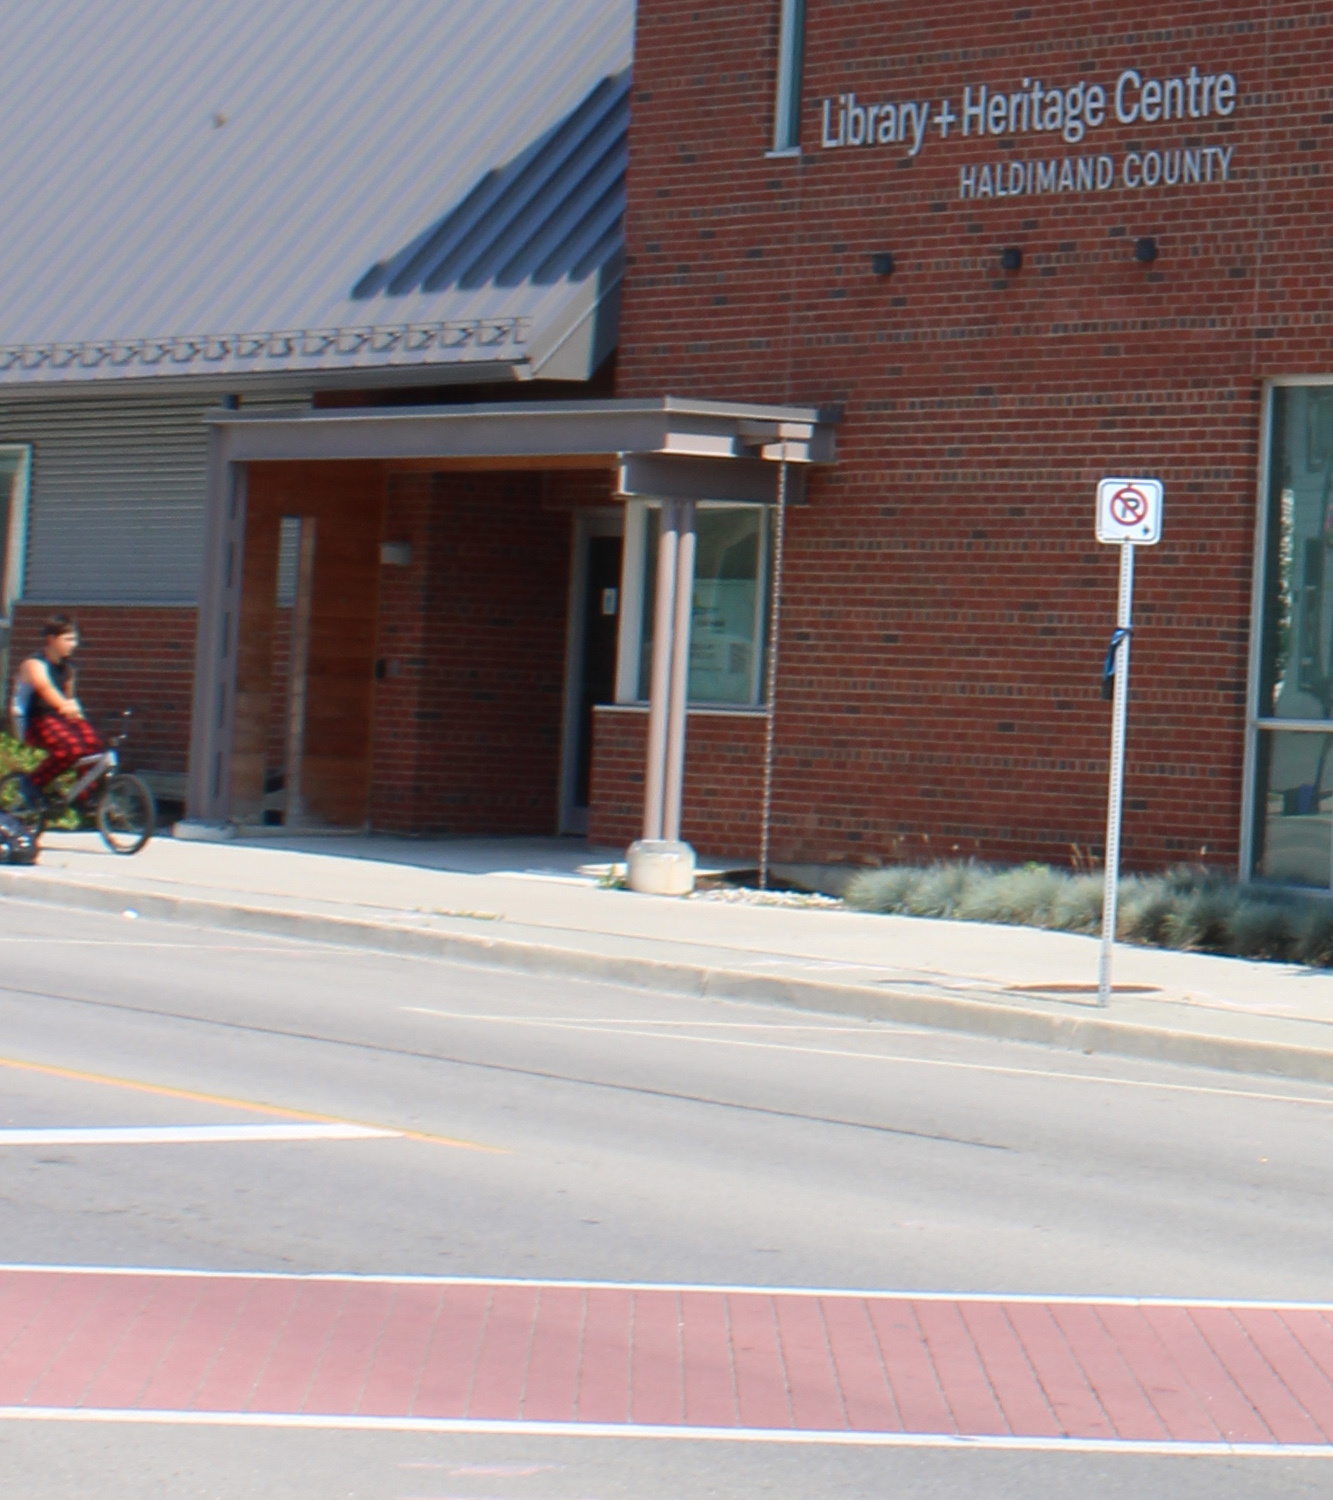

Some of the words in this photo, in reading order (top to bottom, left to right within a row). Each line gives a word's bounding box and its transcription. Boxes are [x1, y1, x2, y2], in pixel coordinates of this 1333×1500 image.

[821, 92, 930, 156] Library
[962, 77, 1106, 144] Heritage
[1114, 66, 1238, 125] Centre
[960, 154, 1115, 199] HALDIMAND
[1123, 146, 1235, 189] COUNTY
